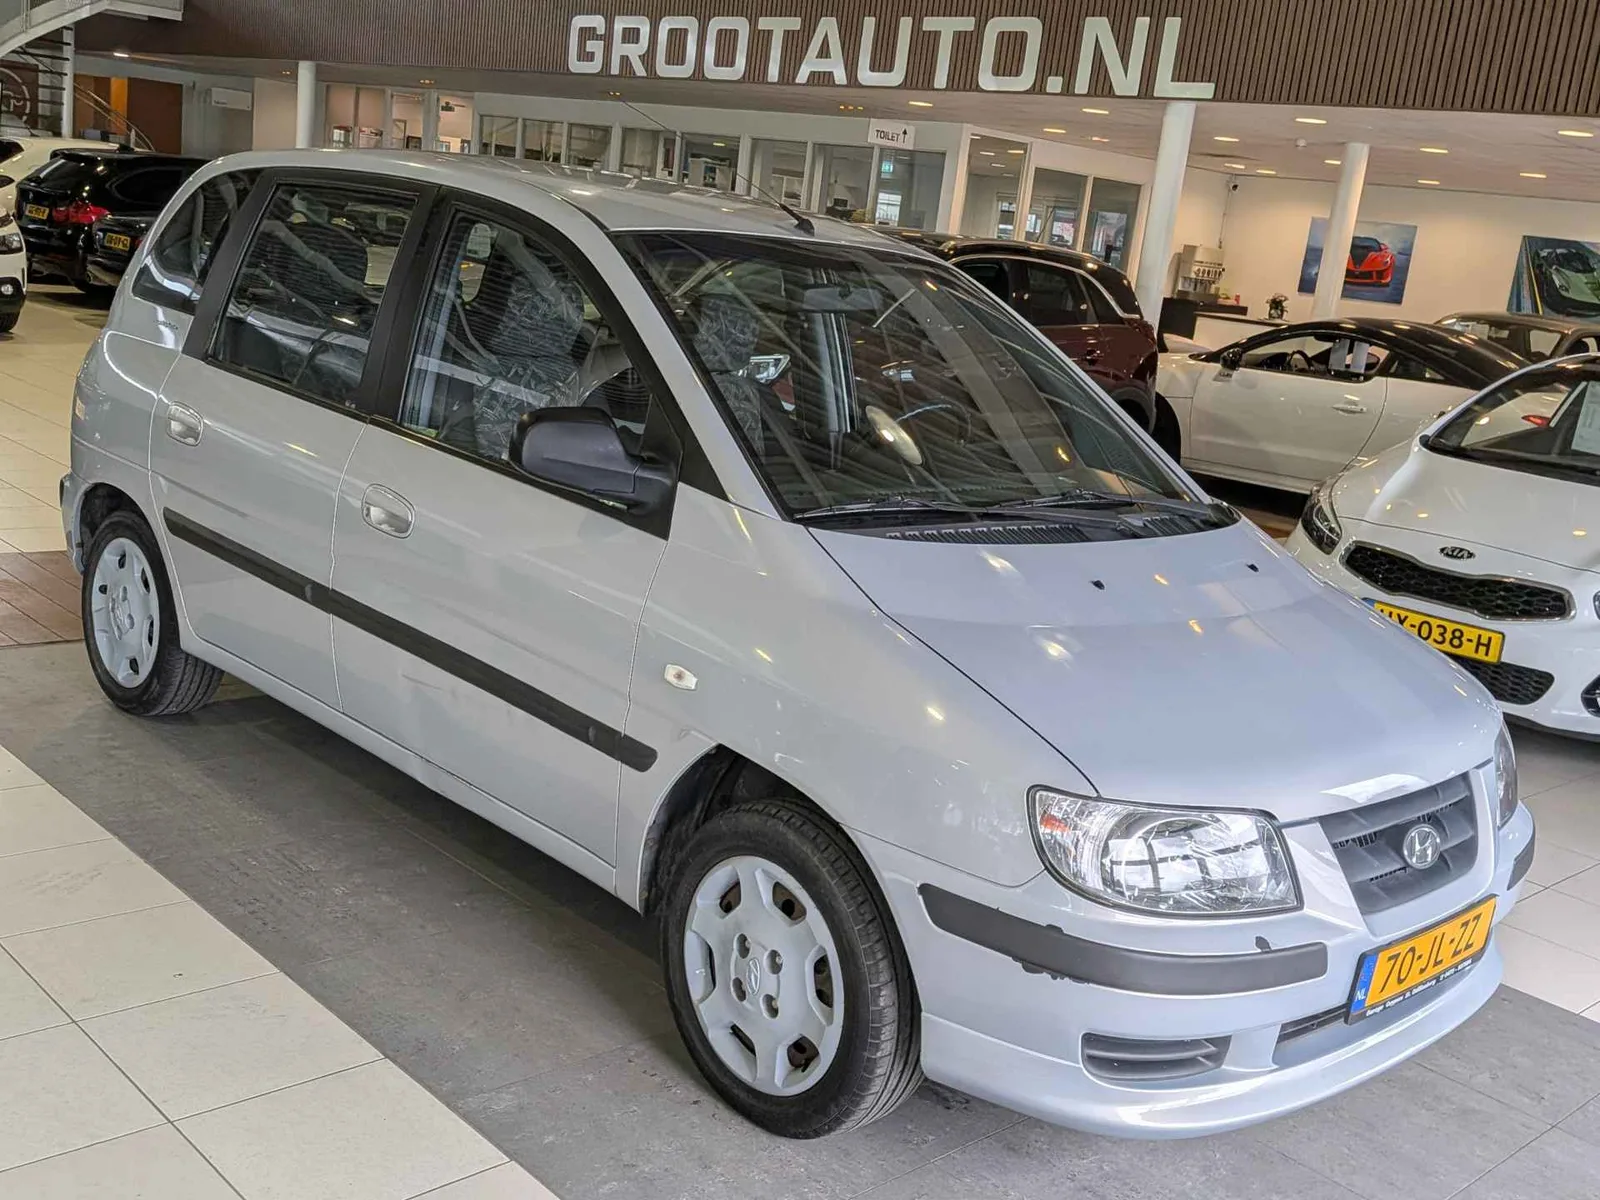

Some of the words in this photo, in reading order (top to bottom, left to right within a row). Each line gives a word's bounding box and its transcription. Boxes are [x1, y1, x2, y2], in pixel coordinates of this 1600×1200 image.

[568, 14, 1215, 99] GROOTAUTO.NL
[875, 129, 900, 142] TOILET
[1380, 608, 1492, 656] X-038-H
[1379, 912, 1482, 994] 70-JL-ZZ
[1355, 987, 1366, 1001] NL
